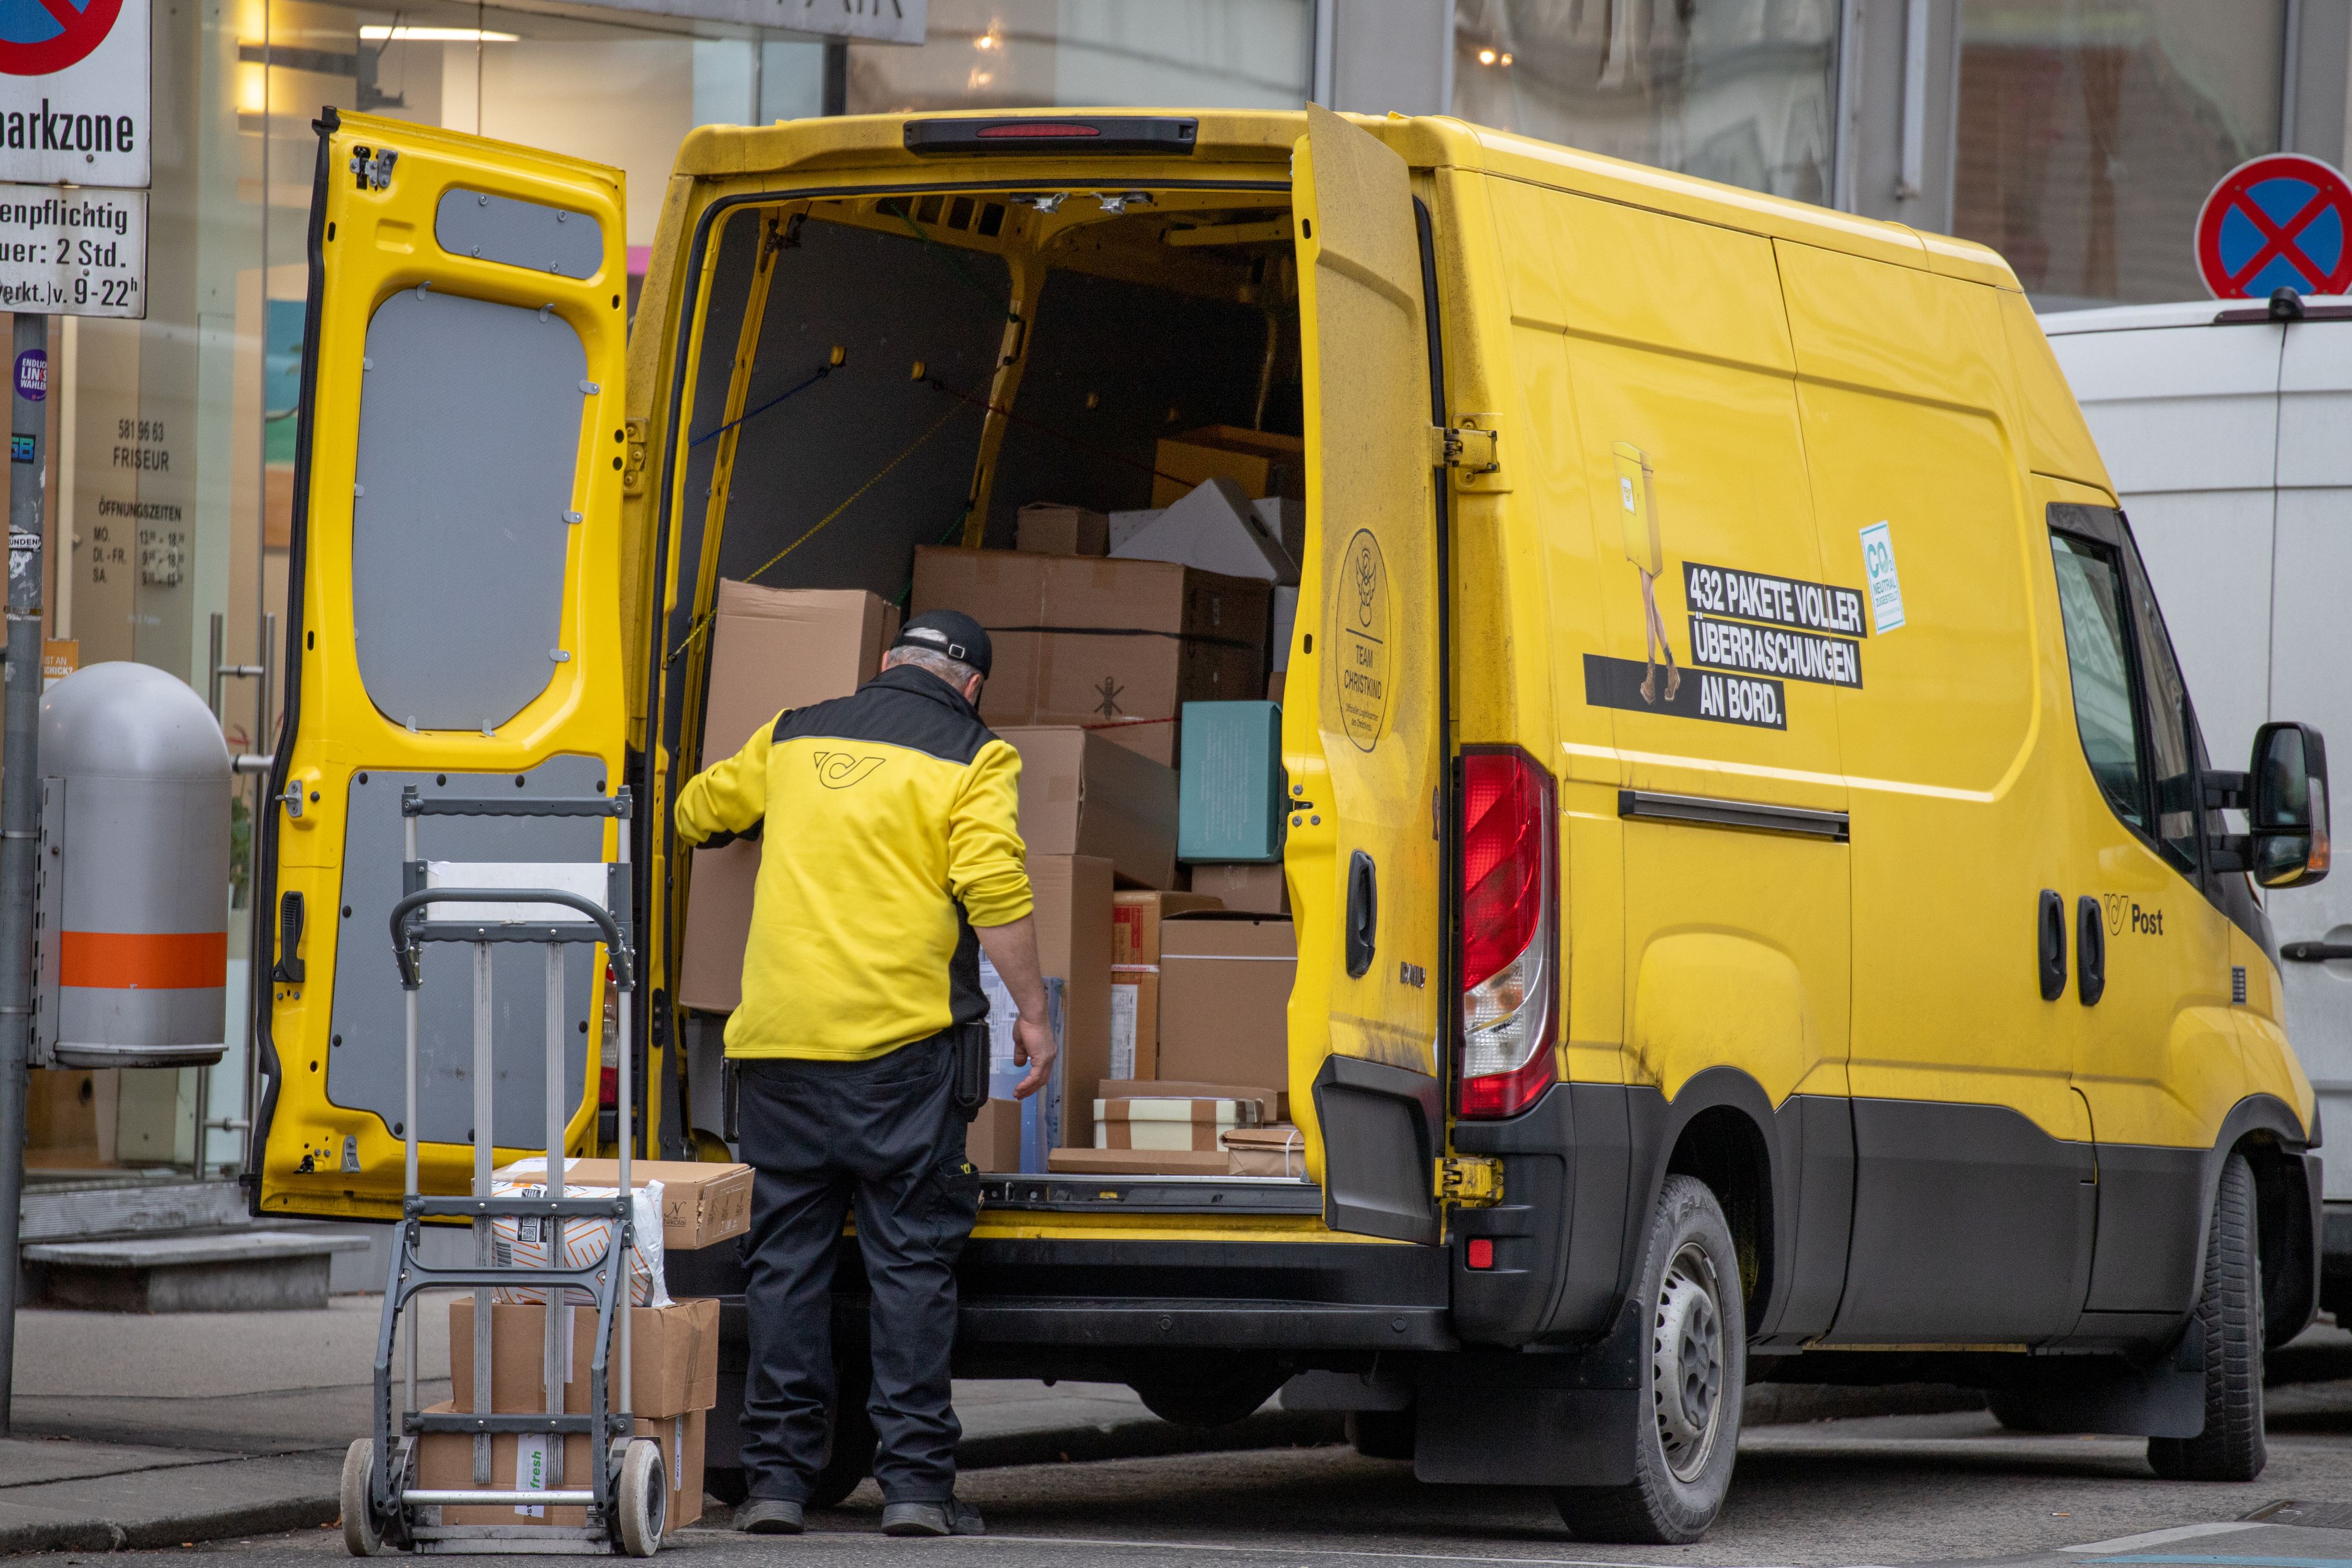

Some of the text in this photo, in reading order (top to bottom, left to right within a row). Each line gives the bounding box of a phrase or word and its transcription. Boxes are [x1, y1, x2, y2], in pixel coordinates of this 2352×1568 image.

[0, 98, 133, 153] arkzone
[0, 199, 128, 235] enpflichtig
[56, 238, 70, 265] 2
[78, 240, 126, 268] Std.
[119, 418, 164, 442] 581 96 63
[113, 446, 169, 472] FRISEUR
[99, 495, 182, 522] ÖFFNUNGSZEITEN
[1690, 568, 1861, 633] 432 PAKETE VOLLER
[1873, 578, 1896, 596] NEUTRAL
[1875, 591, 1898, 607] ZUGESTELLT
[55, 656, 66, 665] AN
[1356, 644, 1373, 668] TEAM
[1694, 611, 1857, 683] ÜBERRASCHUNGEN
[1344, 669, 1382, 700] CHRISTKIND
[1700, 675, 1782, 724] AN BORD.
[2132, 904, 2163, 935] Post
[663, 1218, 687, 1226] Nikolai
[530, 1450, 542, 1489] fresh
